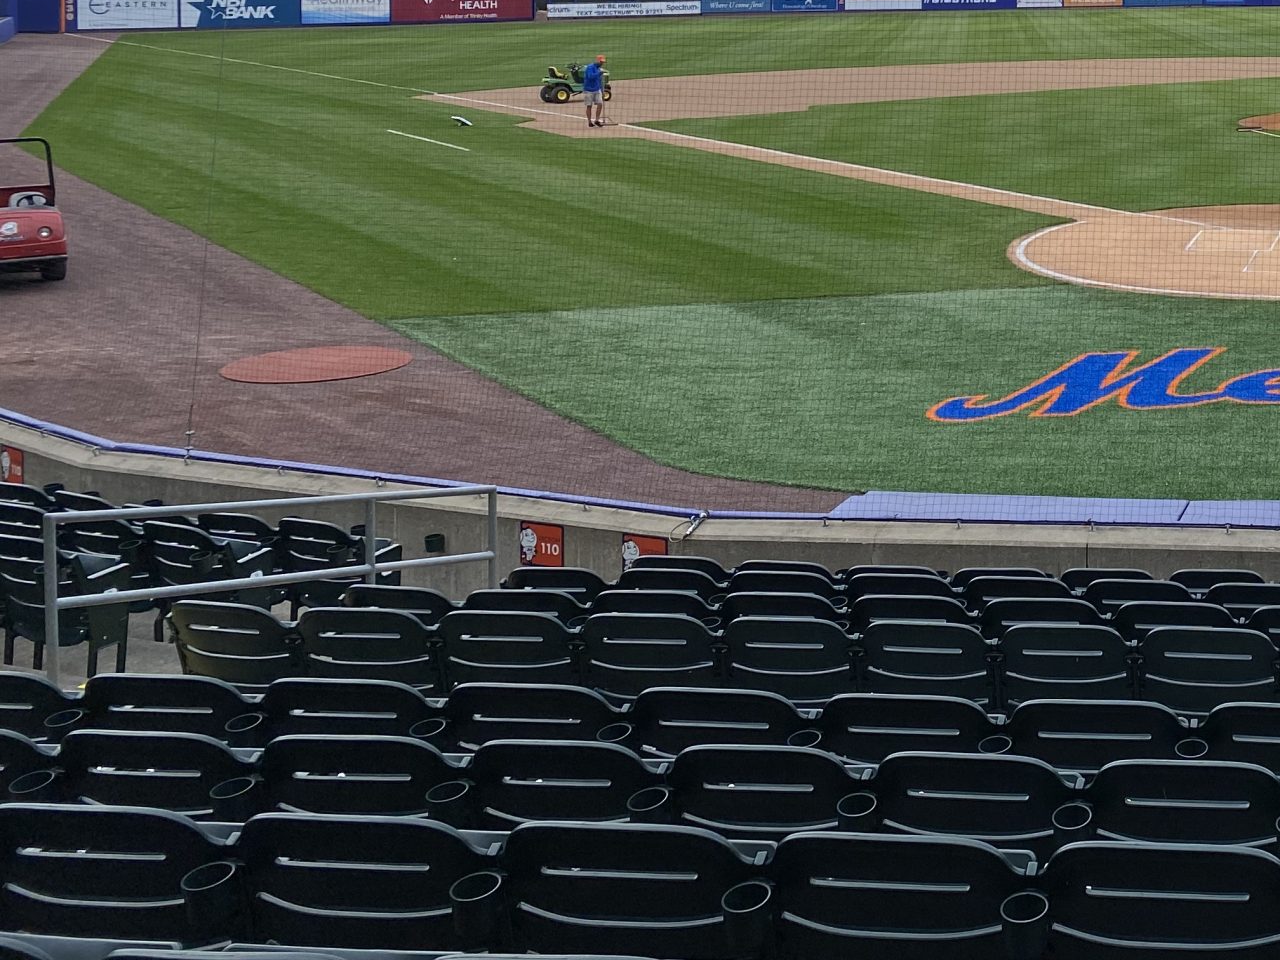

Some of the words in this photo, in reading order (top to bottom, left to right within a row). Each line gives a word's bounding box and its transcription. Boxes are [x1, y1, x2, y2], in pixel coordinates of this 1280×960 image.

[460, 0, 498, 9] HEALTH
[666, 4, 697, 12] Spectrum
[223, 6, 277, 19] BANK
[540, 542, 560, 556] 110
